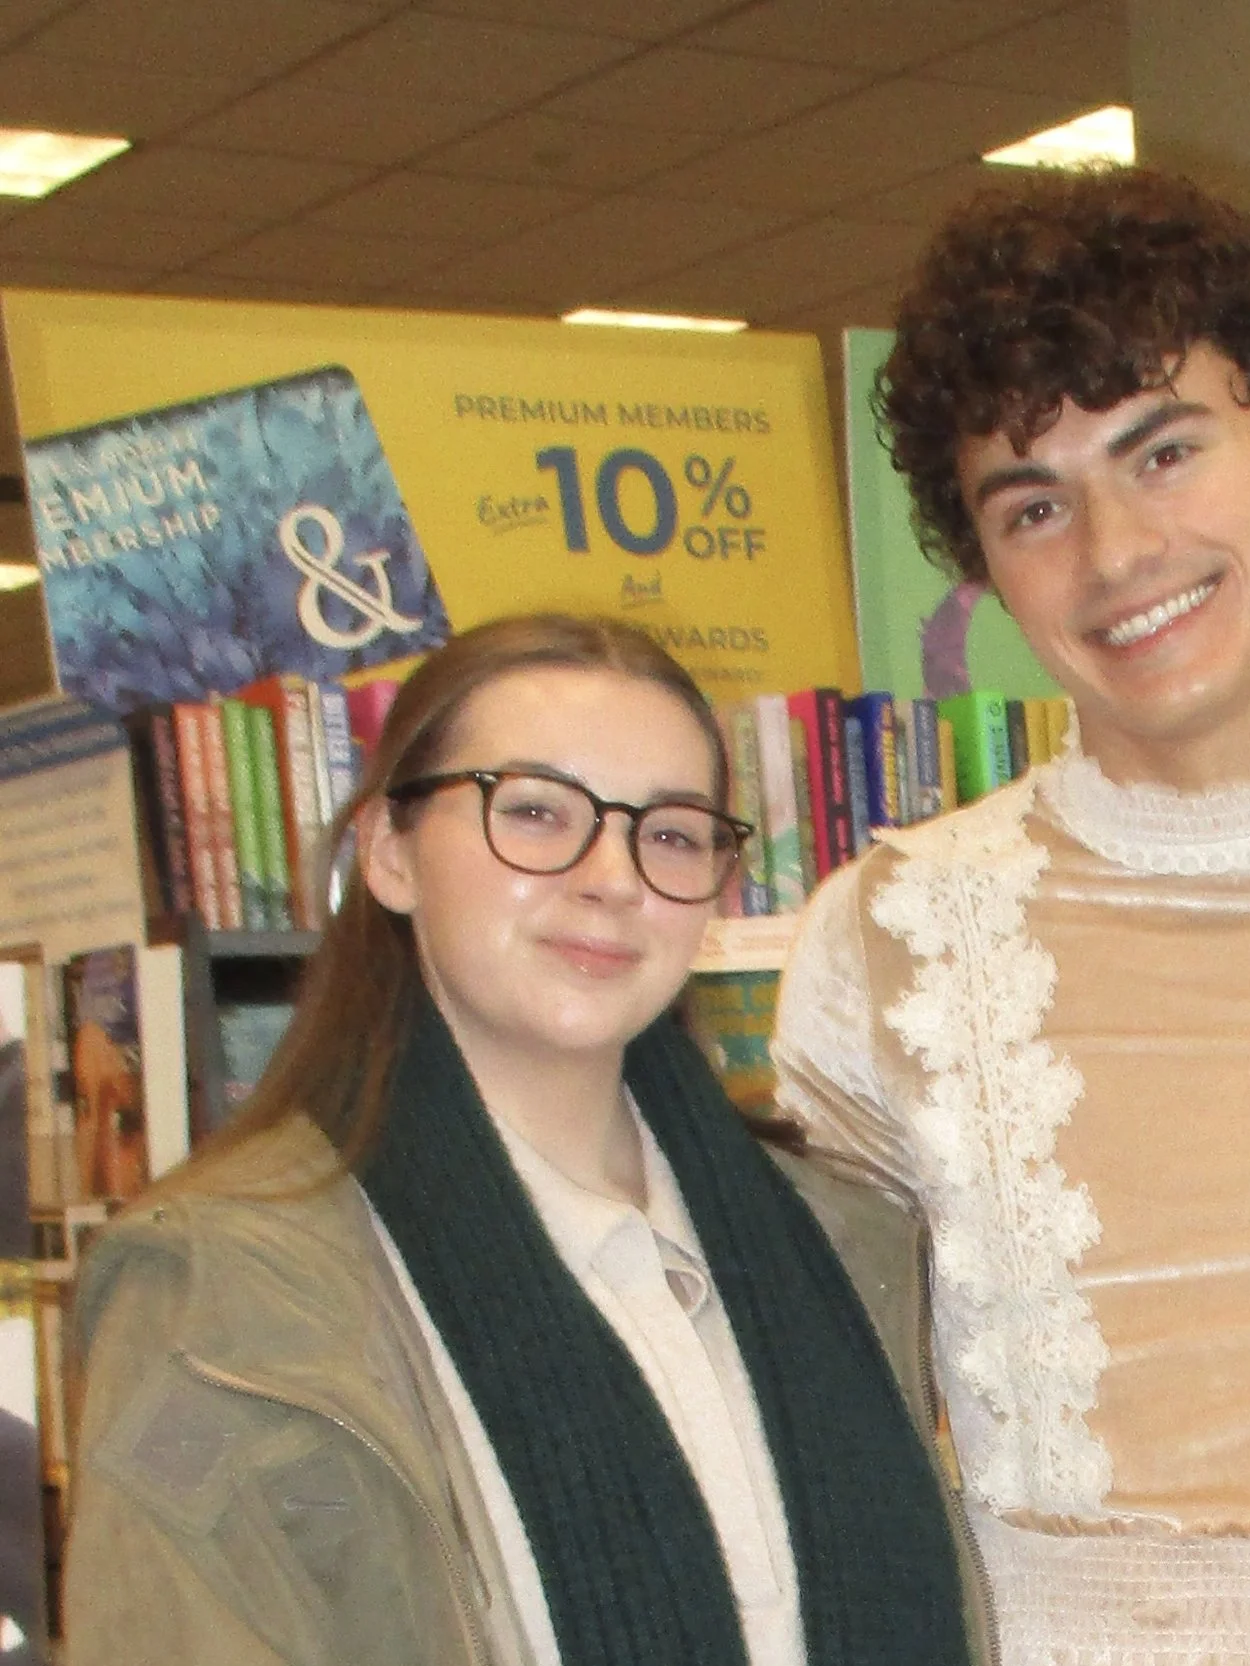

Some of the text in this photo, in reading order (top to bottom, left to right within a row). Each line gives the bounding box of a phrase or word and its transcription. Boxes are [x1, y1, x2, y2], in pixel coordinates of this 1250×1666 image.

[454, 394, 771, 434] PREMIUM MEMBERS
[476, 494, 549, 526] Extra
[683, 525, 766, 560] OFF
[278, 503, 424, 649] &
[620, 570, 663, 599] And
[654, 625, 769, 652] WARDS
